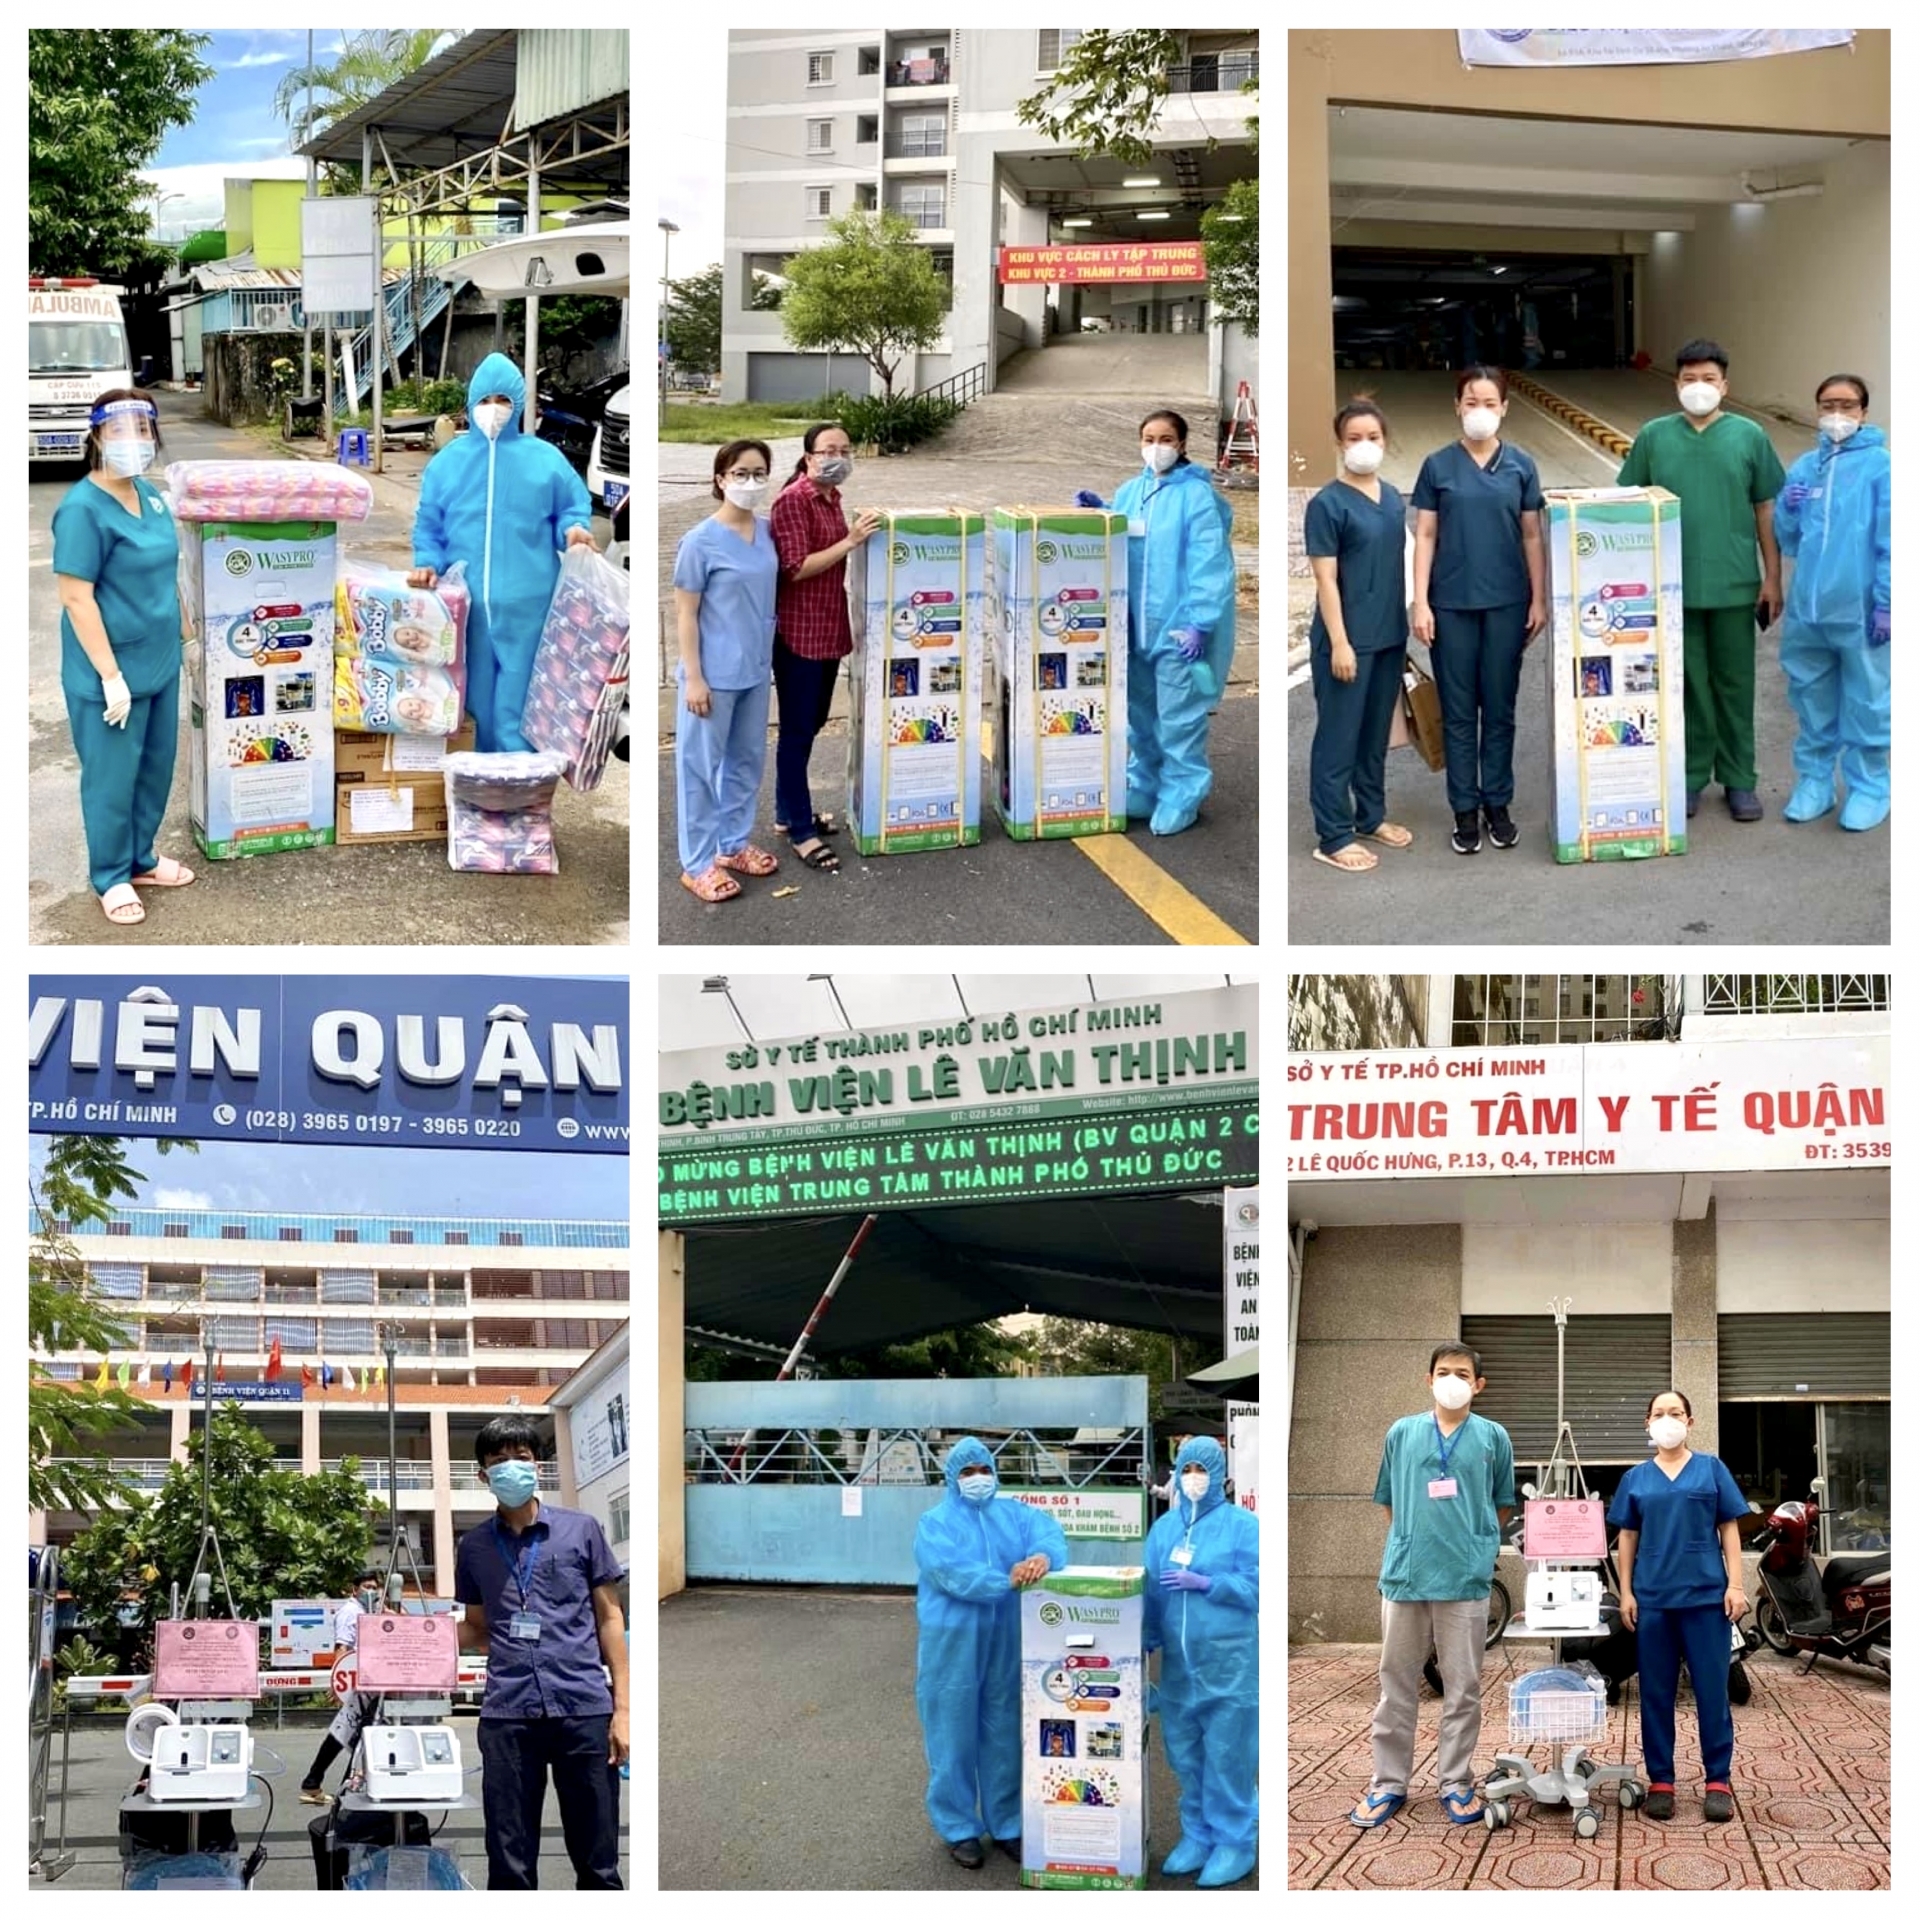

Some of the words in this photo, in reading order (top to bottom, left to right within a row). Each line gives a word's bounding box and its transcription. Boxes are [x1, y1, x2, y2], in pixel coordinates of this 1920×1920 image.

[1009, 251, 1035, 264] KHU
[1038, 249, 1062, 266] VỰC
[1066, 246, 1100, 263] CÁCH
[1103, 249, 1119, 262] LY
[1123, 247, 1148, 264] TẬP
[1151, 247, 1197, 260] TRUNG
[1008, 267, 1031, 280] KHU
[1033, 266, 1056, 282] VỰC
[1058, 267, 1067, 279] 2
[1077, 264, 1115, 278] THÀNH
[1118, 263, 1143, 278] PHỐ
[1145, 262, 1169, 277] THỦ
[1171, 262, 1197, 277] ĐỨC
[257, 550, 315, 570] WASYPRO
[367, 598, 389, 654] Bobby
[370, 669, 393, 726] Bobby
[727, 1043, 759, 1070] SỞ
[765, 1047, 781, 1066] Y
[788, 1036, 820, 1064] TẾ
[825, 1032, 909, 1060] THÀNH
[918, 1017, 975, 1049] PHỐ
[982, 1012, 1018, 1043] HỒ
[1029, 1008, 1079, 1038] CHÍ
[1087, 1003, 1162, 1031] MINH
[311, 1003, 623, 1107] QUẬN
[658, 1080, 775, 1130] BỆNH
[789, 1065, 893, 1115] VIỆN
[907, 1053, 961, 1102] LÊ
[978, 1046, 1075, 1094] VĂN
[1091, 1031, 1247, 1085] THỊNH
[1288, 1059, 1314, 1081] SỞ
[1320, 1064, 1334, 1081] Y
[1341, 1057, 1370, 1080] TẾ
[1375, 1055, 1440, 1080] TP.HỒ
[1445, 1057, 1484, 1078] CHÍ
[1490, 1059, 1546, 1076] MINH
[29, 1097, 78, 1120] P.HỒ
[84, 1101, 119, 1121] CHÍ
[126, 1105, 177, 1124] MINH
[989, 1106, 1014, 1119] 5432
[1288, 1100, 1448, 1141] TRUNG
[1470, 1091, 1577, 1136] TÂM
[1597, 1096, 1631, 1133] Y
[1651, 1081, 1722, 1132] TẾ
[1743, 1082, 1885, 1137] QUẬN
[245, 1110, 296, 1132] (028)
[302, 1113, 349, 1132] 3965
[356, 1115, 403, 1133] 0197
[423, 1117, 469, 1135] 3965
[475, 1119, 521, 1137] 0220
[673, 1158, 741, 1182] MỪNG
[820, 1146, 876, 1172] VIỆN
[885, 1141, 915, 1164] LÊ
[925, 1138, 975, 1160] VĂN
[986, 1131, 1062, 1158] THỊNH
[1074, 1125, 1119, 1154] (BV
[1129, 1115, 1206, 1147] QUẬN
[1219, 1116, 1233, 1137] 2
[1804, 1144, 1838, 1160] ĐT:
[1842, 1142, 1891, 1159] 3539
[1298, 1152, 1322, 1172] LÊ
[1326, 1150, 1380, 1174] QUỐC
[1384, 1152, 1443, 1172] HƯNG,
[1449, 1152, 1495, 1171] P.13,
[1501, 1150, 1539, 1169] Q.4,
[1544, 1149, 1616, 1166] TP.HCM
[659, 1189, 719, 1213] BỆNH
[726, 1183, 780, 1209] VIỆN
[789, 1178, 871, 1201] TRUNG
[880, 1171, 929, 1194] TÂM
[940, 1164, 1024, 1189] THÀNH
[1100, 1150, 1152, 1178] THỦ
[1163, 1148, 1223, 1173] ĐỨC
[1240, 1298, 1257, 1315] AN
[1075, 1495, 1081, 1505] 1
[1122, 1521, 1133, 1534] SỐ
[1134, 1524, 1140, 1533] 2
[1067, 1605, 1120, 1622] WASYPRO
[335, 1669, 357, 1693] ST
